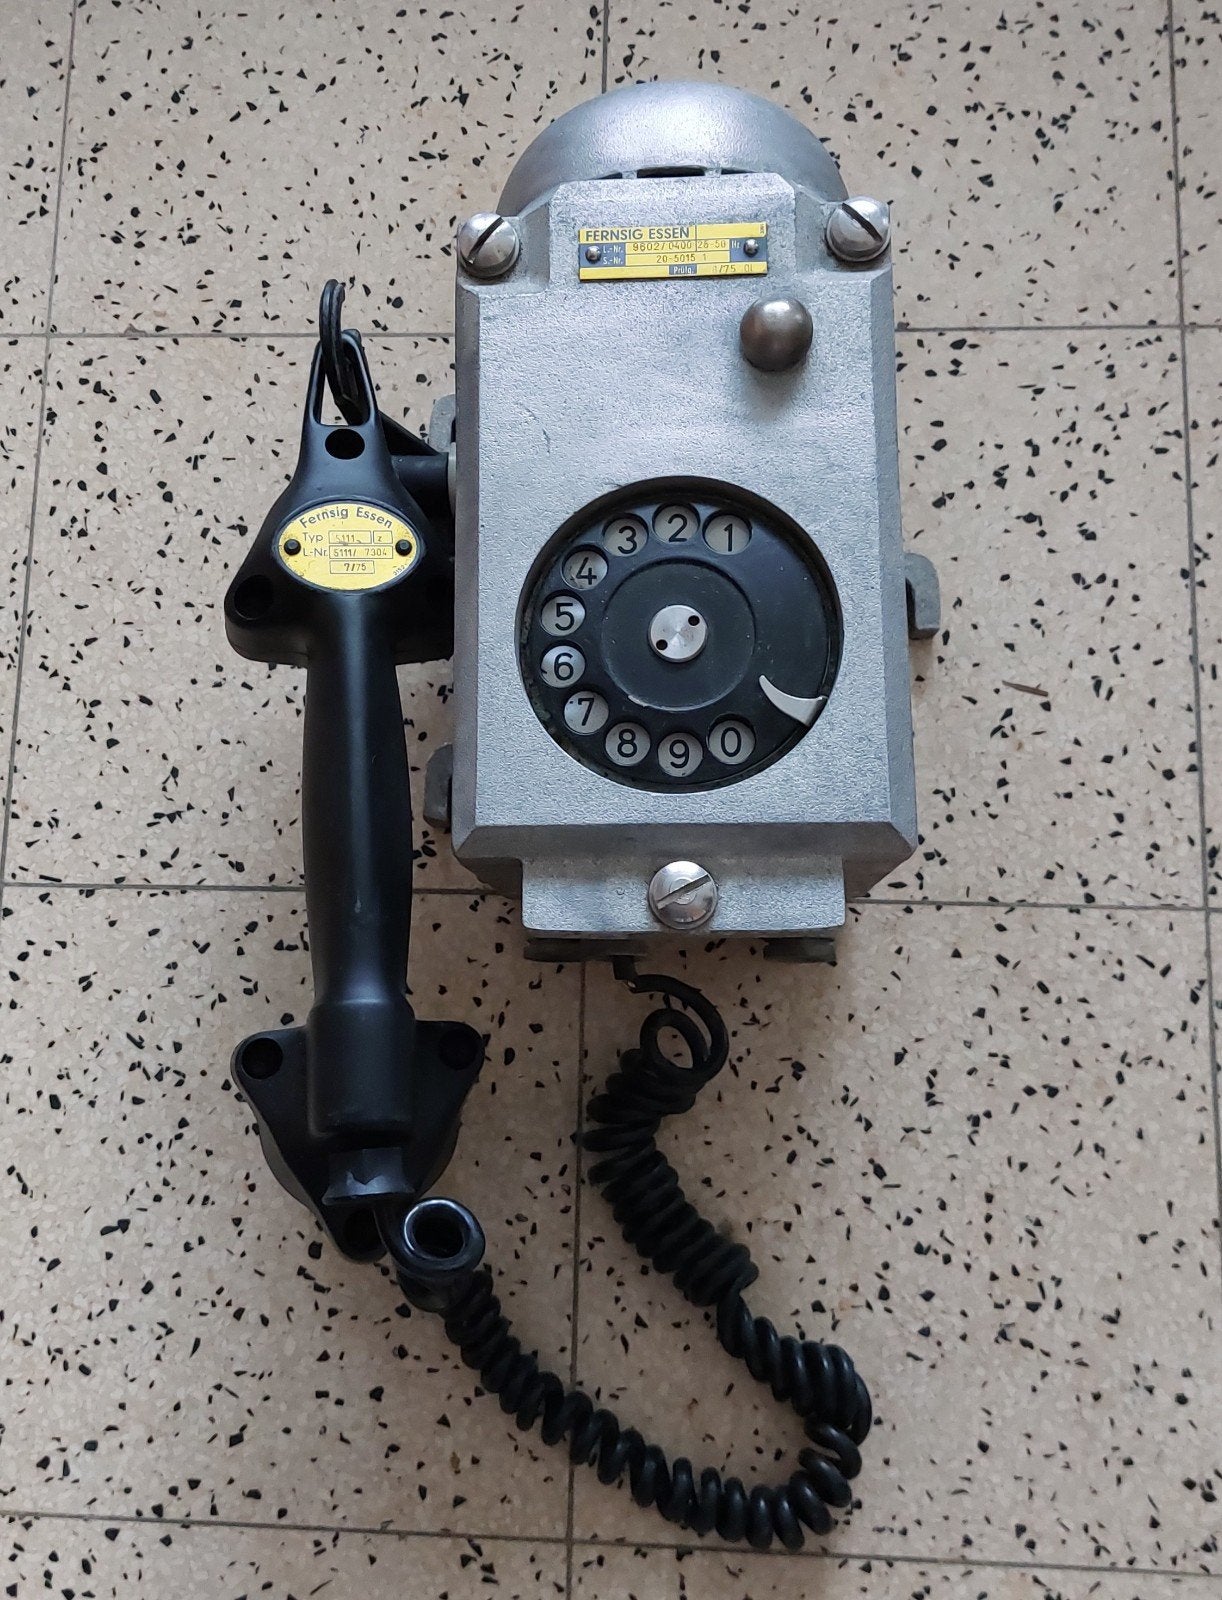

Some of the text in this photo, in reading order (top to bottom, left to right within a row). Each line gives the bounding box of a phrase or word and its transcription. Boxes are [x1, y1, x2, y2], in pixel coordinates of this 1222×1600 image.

[586, 226, 690, 241] FERNSIG ESSEN
[300, 506, 393, 529] Fernsig Essen
[667, 513, 688, 543] 2
[302, 532, 324, 543] Typ
[617, 525, 638, 554] 3
[723, 523, 733, 552] 1
[575, 556, 597, 585] 4
[554, 602, 574, 631] 5
[553, 652, 574, 681] 6
[577, 697, 595, 726] 7
[617, 728, 638, 758] 8
[669, 739, 690, 769] 9
[720, 727, 742, 757] 0
